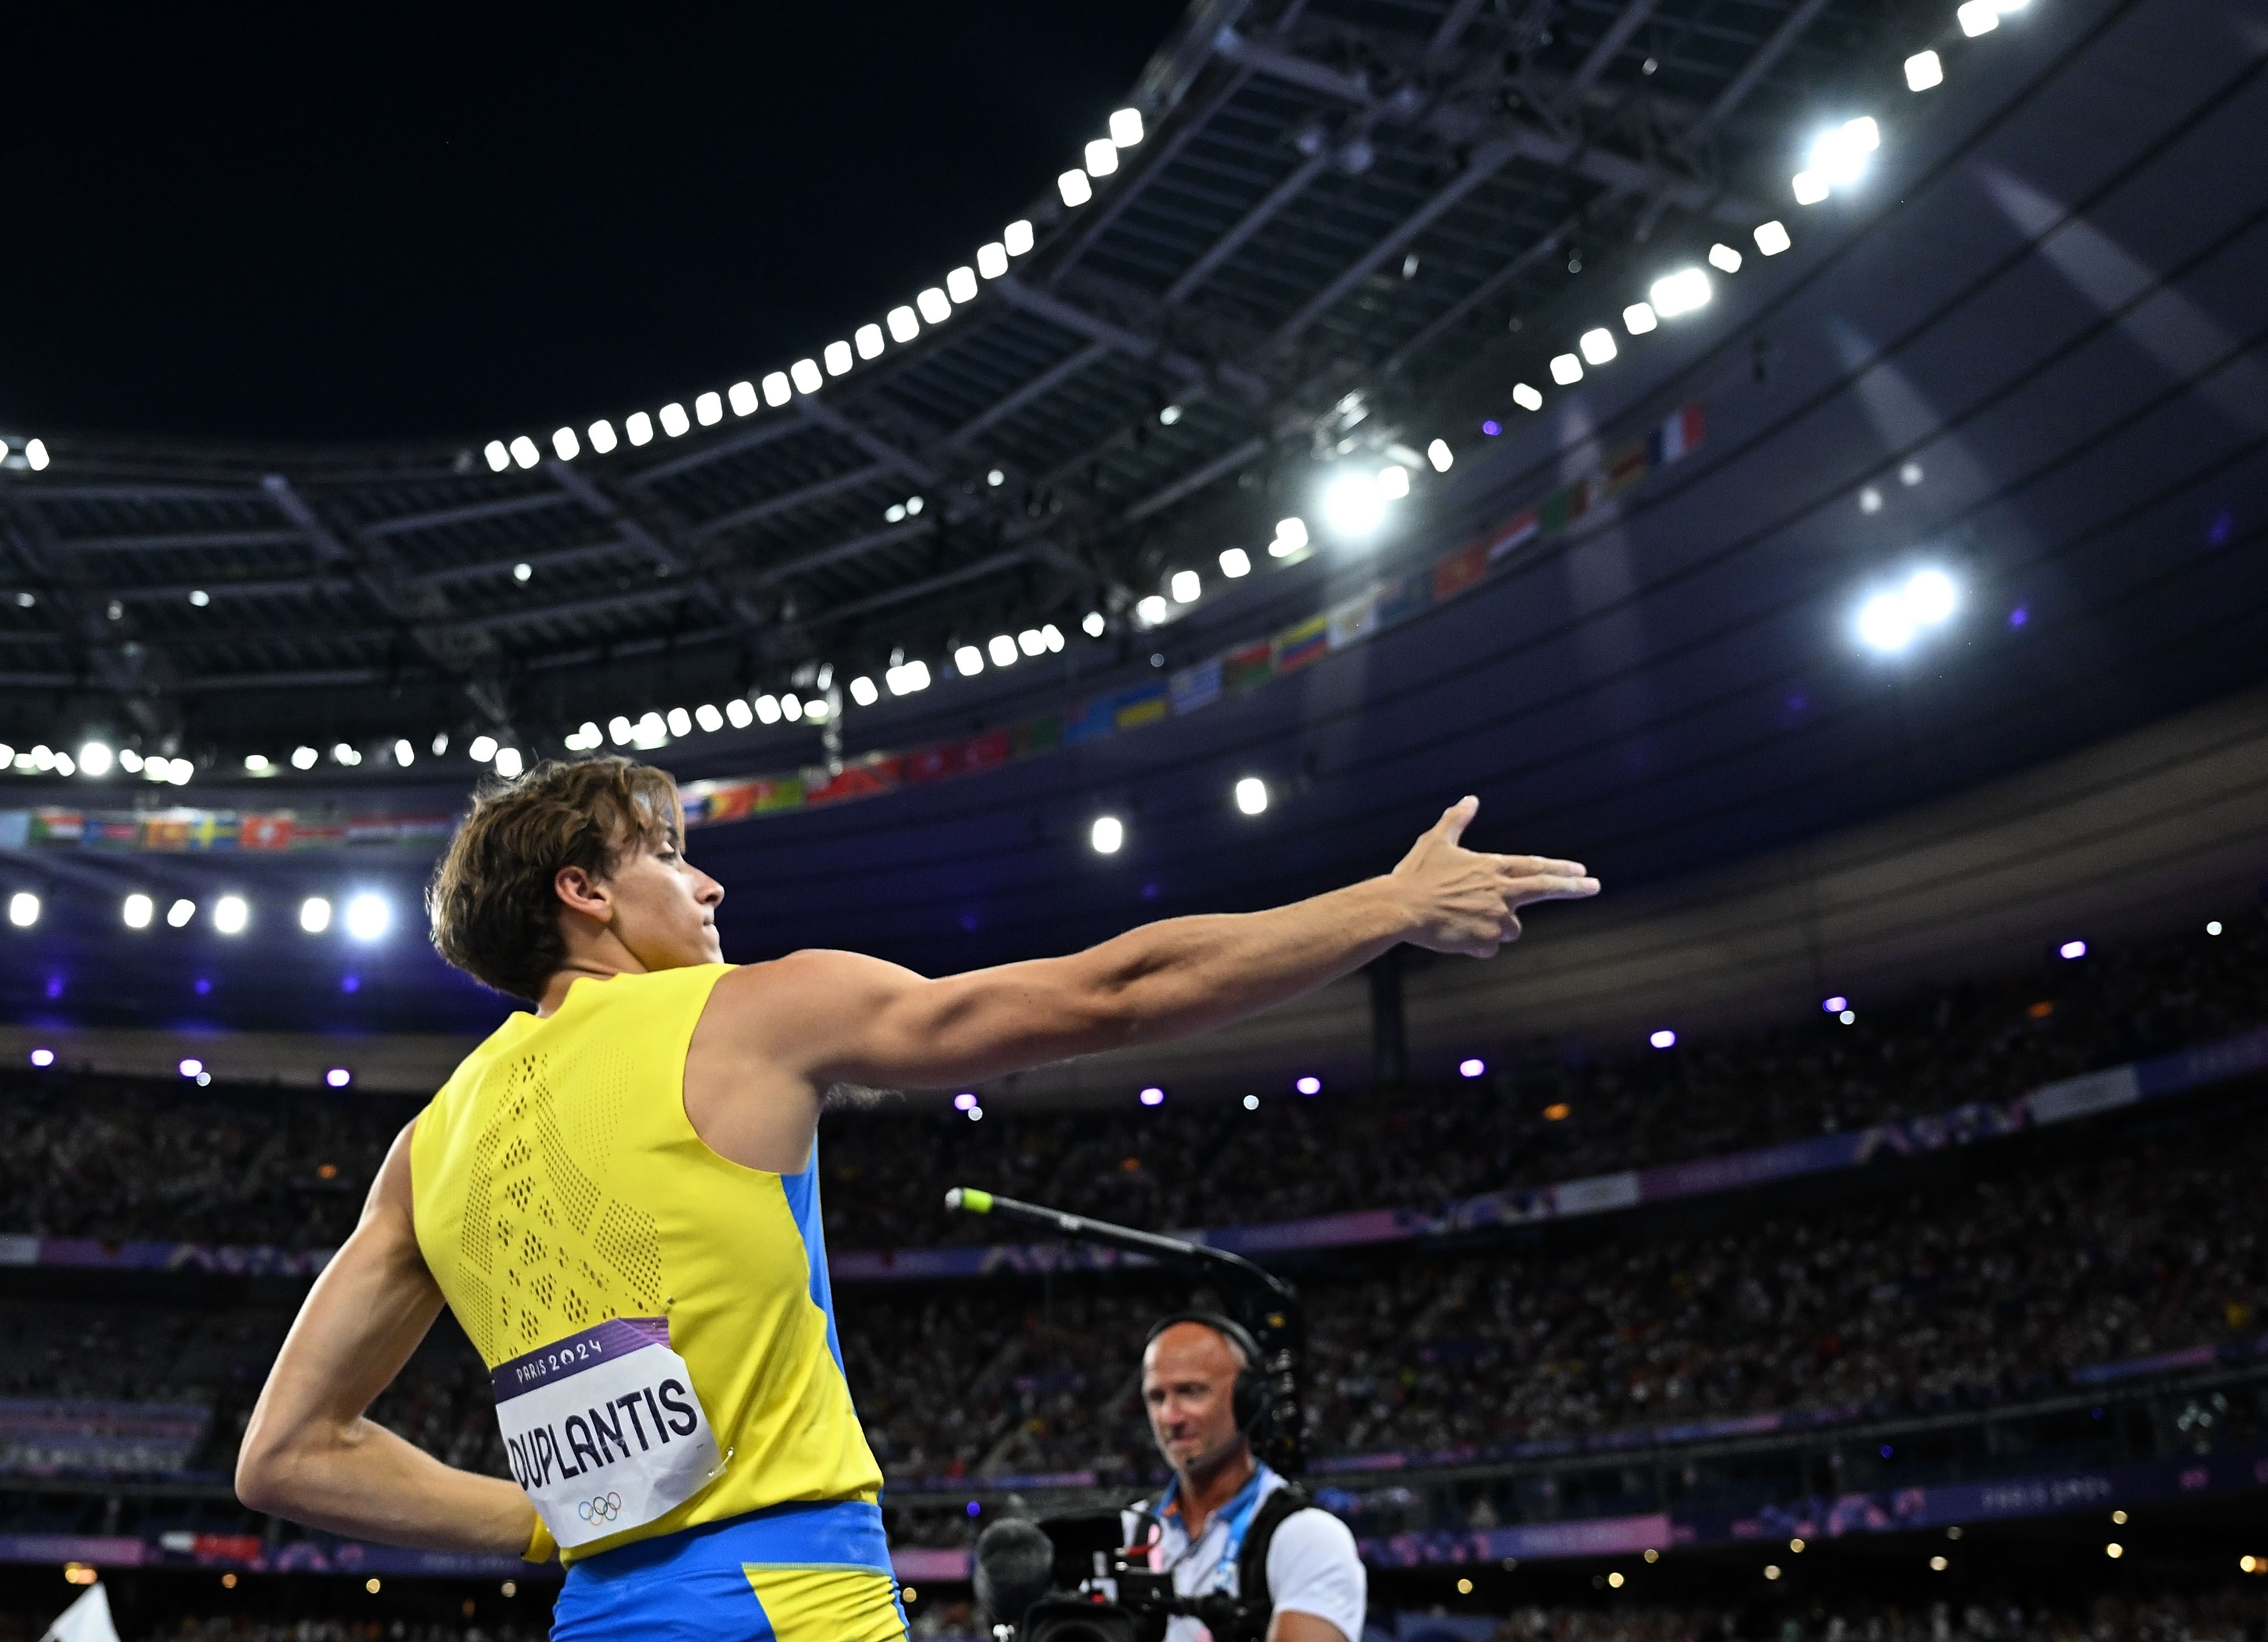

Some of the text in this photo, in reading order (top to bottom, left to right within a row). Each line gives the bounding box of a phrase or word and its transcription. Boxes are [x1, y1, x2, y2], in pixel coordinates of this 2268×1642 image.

[516, 1339, 602, 1383] PARIS 2024
[508, 1378, 698, 1491] DUPLANTIS
